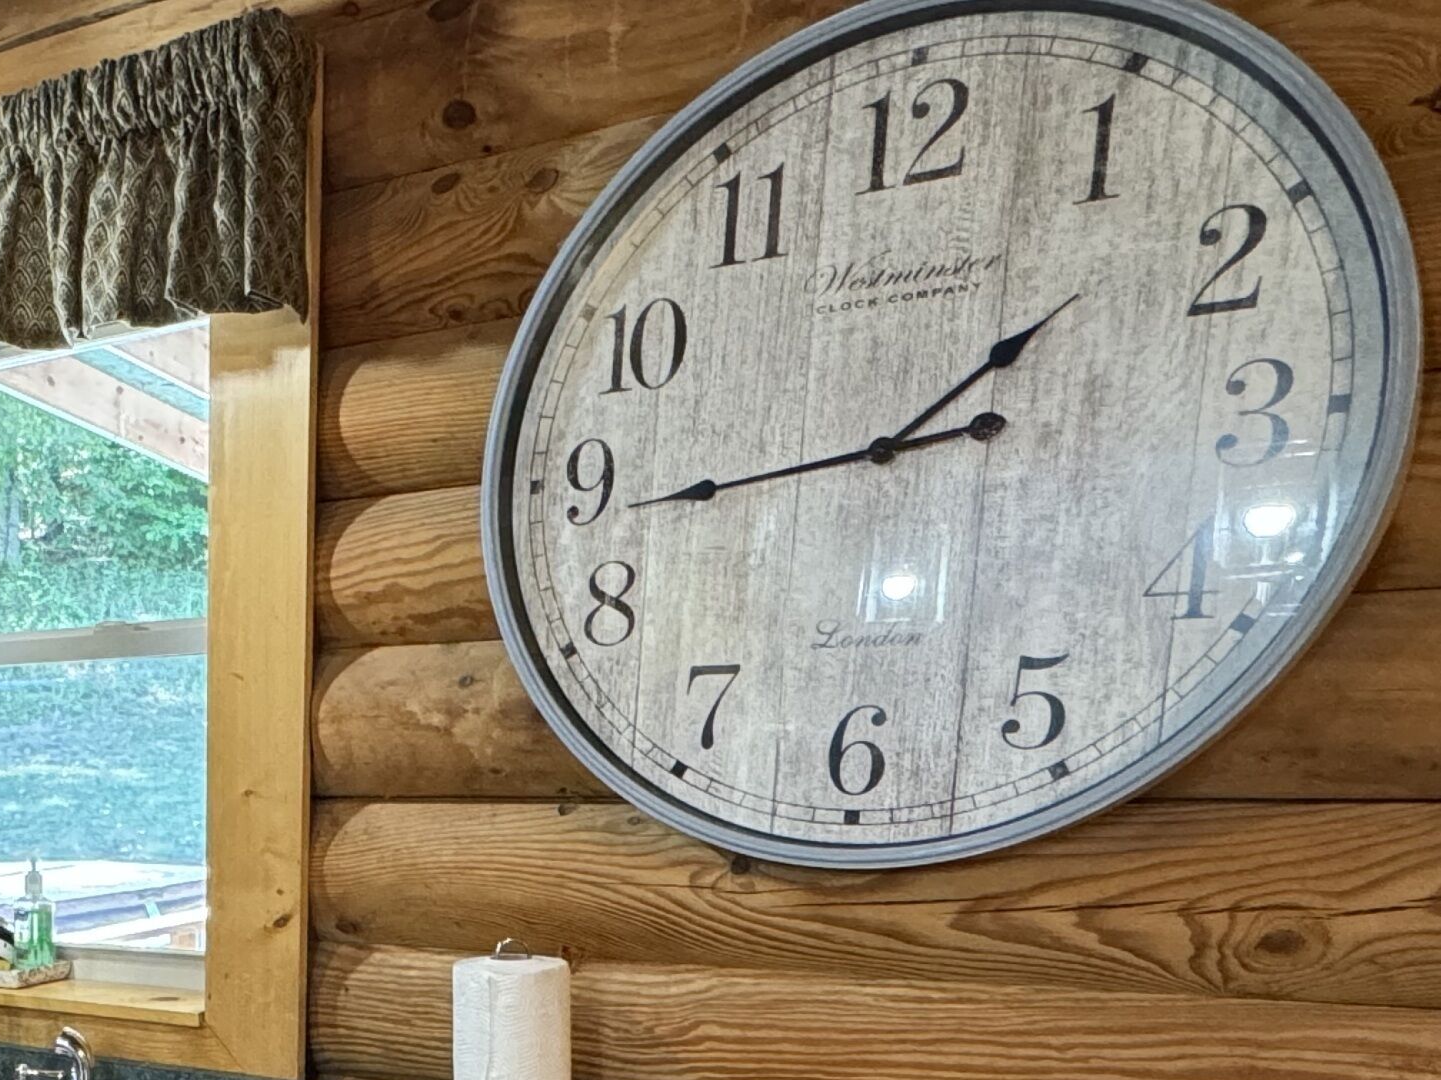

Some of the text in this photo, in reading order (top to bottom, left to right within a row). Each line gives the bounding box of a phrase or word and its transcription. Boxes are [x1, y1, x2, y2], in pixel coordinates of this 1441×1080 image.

[855, 77, 970, 196] 12
[1072, 94, 1120, 205] 1
[709, 161, 788, 269] 11
[1187, 204, 1268, 317] 2
[803, 249, 1003, 297] Westminster
[816, 281, 983, 315] CLOCK COMPANY
[599, 297, 688, 395] 10
[1214, 358, 1294, 467] 3
[565, 438, 616, 526] 9
[583, 560, 636, 647] 8
[1141, 515, 1220, 620] 4
[811, 618, 922, 649] London
[687, 663, 741, 750] 7
[1000, 654, 1070, 749] 5
[827, 704, 887, 795] 6
